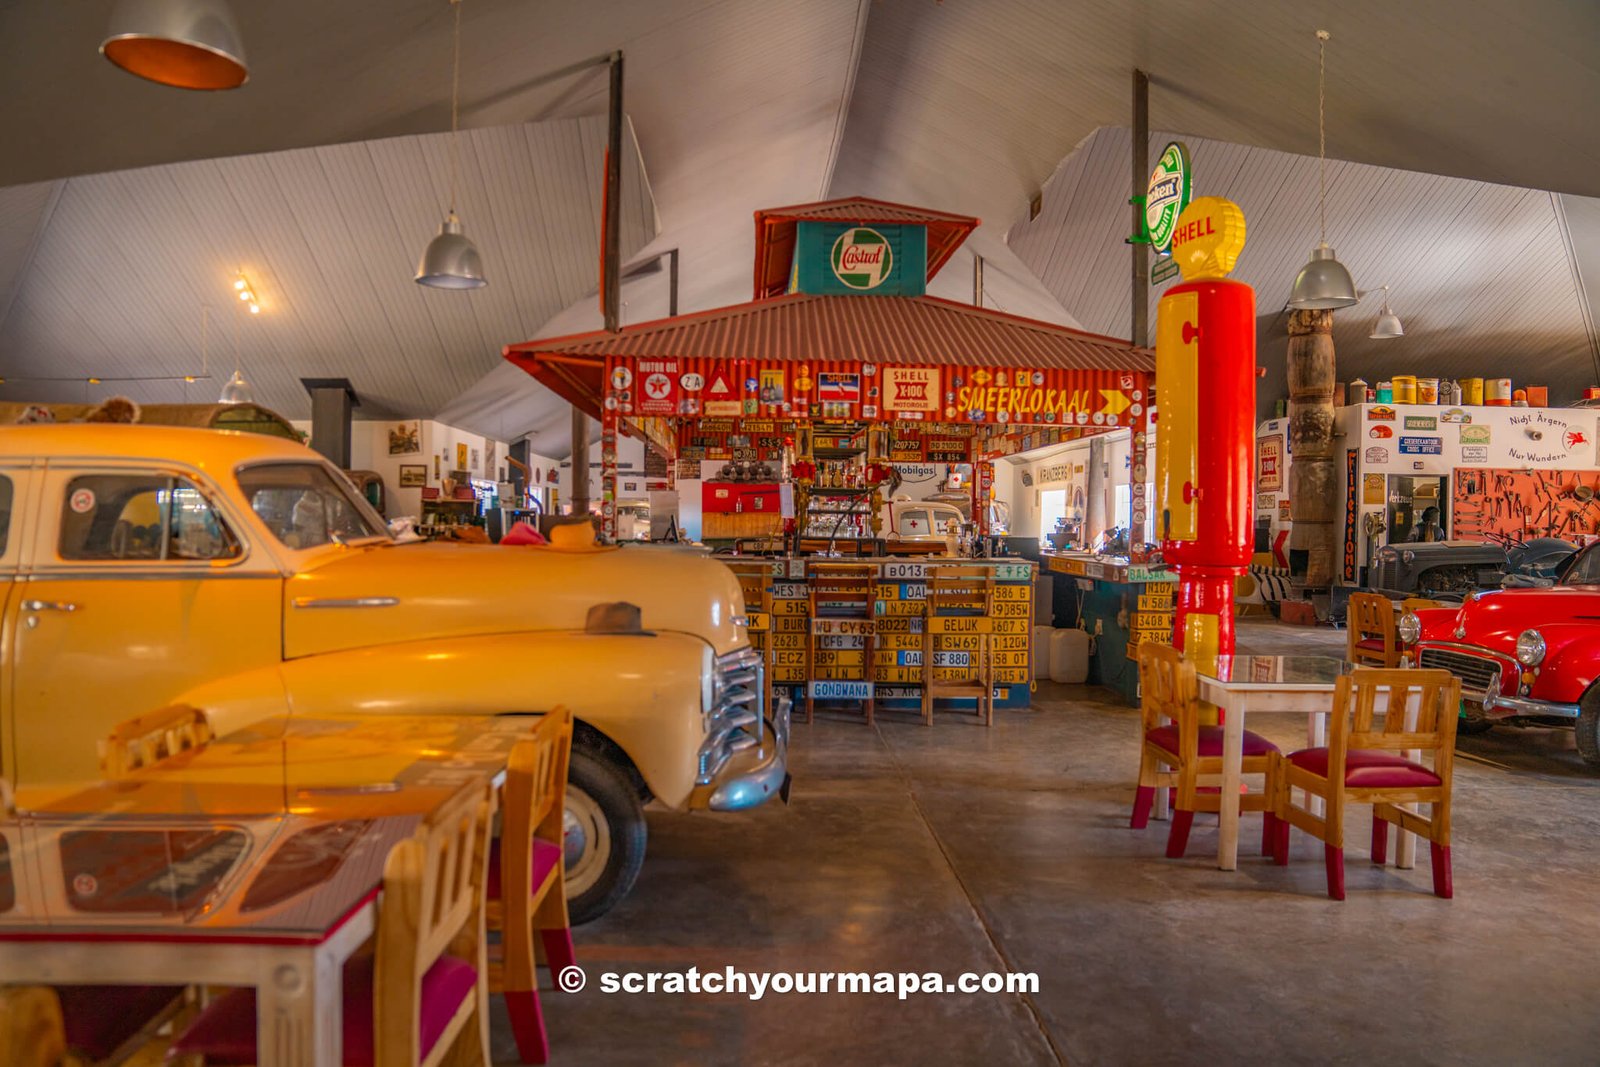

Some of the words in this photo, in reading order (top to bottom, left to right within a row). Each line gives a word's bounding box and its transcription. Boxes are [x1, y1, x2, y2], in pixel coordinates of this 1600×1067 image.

[1172, 216, 1216, 248] SHELL
[842, 245, 883, 271] Castrol
[894, 371, 929, 381] SHELL
[900, 384, 923, 398] X-100
[957, 386, 1090, 414] SMEERLOKAAL
[1509, 448, 1524, 460] Nur
[1526, 453, 1567, 462] Wundern
[894, 465, 934, 477] Mobilgas
[786, 602, 807, 613] 515
[878, 619, 908, 631] 8022
[944, 619, 978, 632] GELUK
[774, 635, 799, 647] 2628
[779, 652, 804, 665] ECZ
[949, 653, 969, 666] 880
[814, 682, 868, 697] GONDWANA
